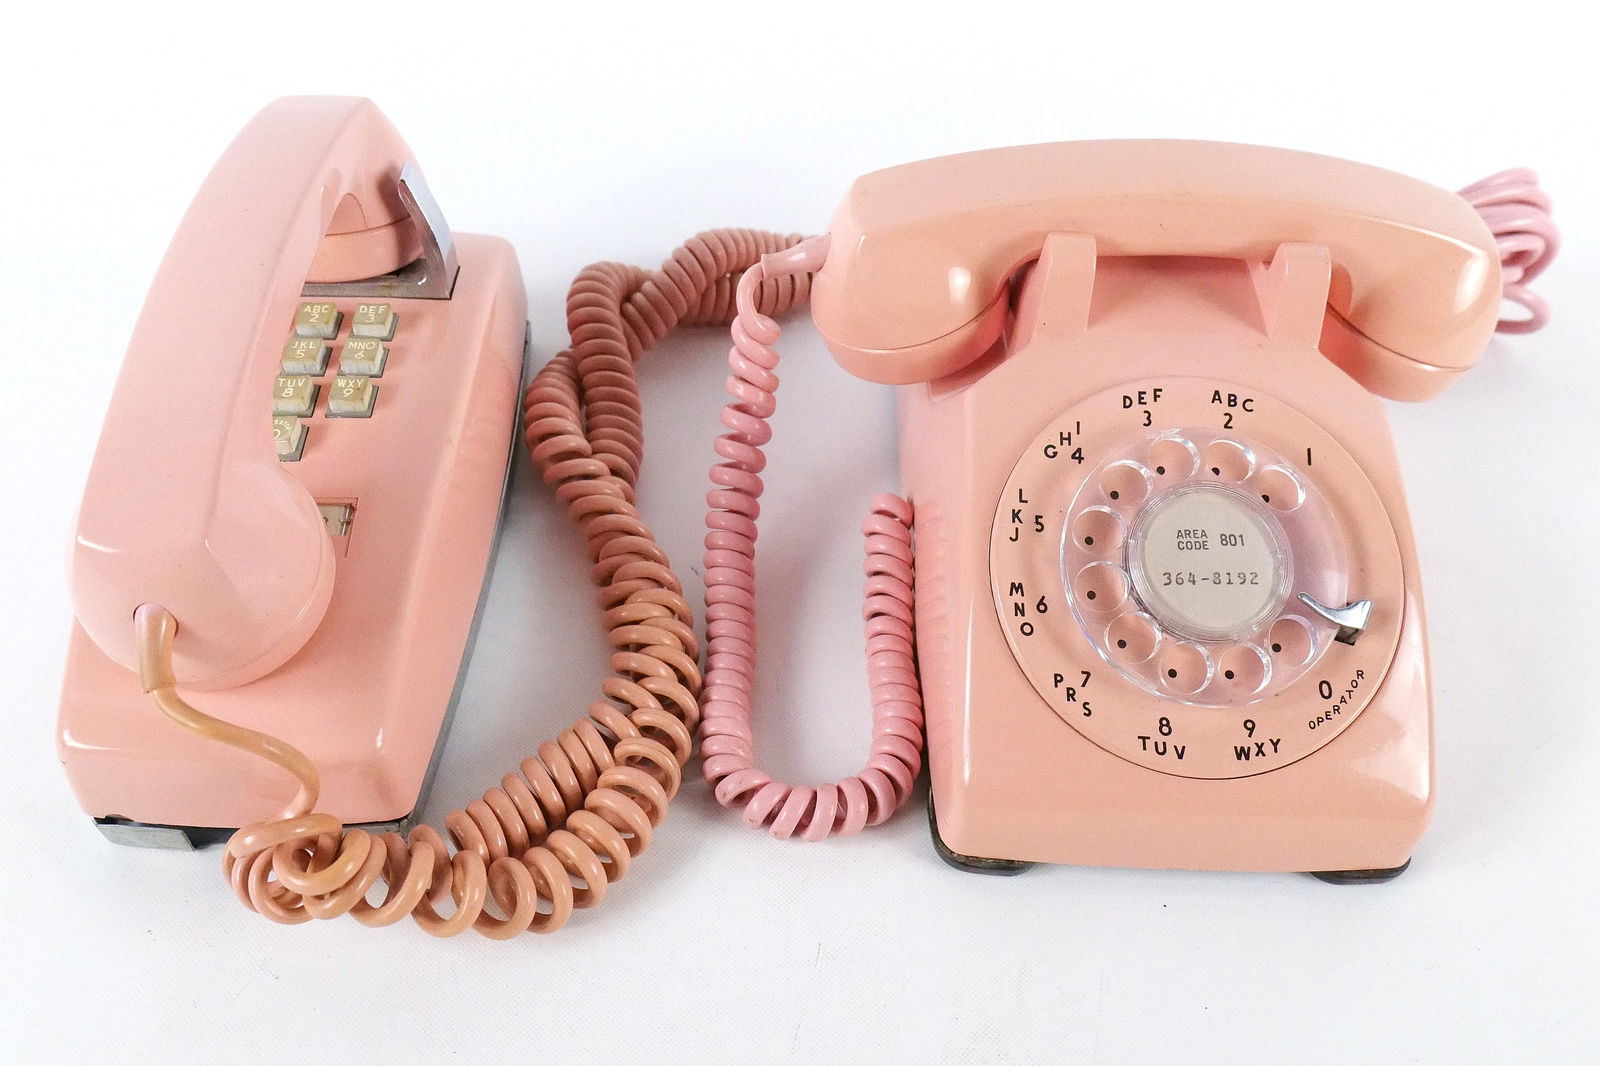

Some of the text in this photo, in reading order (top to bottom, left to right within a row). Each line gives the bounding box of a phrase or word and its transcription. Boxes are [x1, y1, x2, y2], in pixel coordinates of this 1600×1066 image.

[304, 305, 329, 313] ABC
[359, 305, 386, 314] DEF
[309, 314, 319, 322] 2
[366, 314, 375, 322] 3
[291, 341, 316, 349] JKL
[348, 341, 376, 349] MNO
[295, 350, 306, 358] 5
[355, 350, 365, 359] 6
[278, 378, 306, 387] TUV
[337, 379, 364, 388] WXY
[282, 388, 293, 397] 8
[343, 389, 354, 397] 9
[1122, 388, 1163, 409] DEF
[1211, 389, 1254, 413] ABC
[1143, 411, 1152, 427] 3
[1223, 413, 1234, 429] 2
[1071, 447, 1085, 464] 4
[1034, 515, 1045, 533] 5
[1176, 530, 1208, 539] AREA
[1219, 533, 1245, 547] 801
[1177, 541, 1210, 551] CODE
[1162, 571, 1259, 587] 364-8192
[1009, 582, 1035, 637] MNO
[1036, 597, 1048, 613] 6
[1080, 671, 1091, 687] 7
[1054, 673, 1093, 717] PRS
[1319, 680, 1333, 700] 0
[1308, 669, 1364, 730] OPERATOR
[1157, 717, 1173, 736] 8
[1243, 719, 1256, 737] 9
[1137, 736, 1186, 760] TUV
[1234, 739, 1281, 761] WXY
